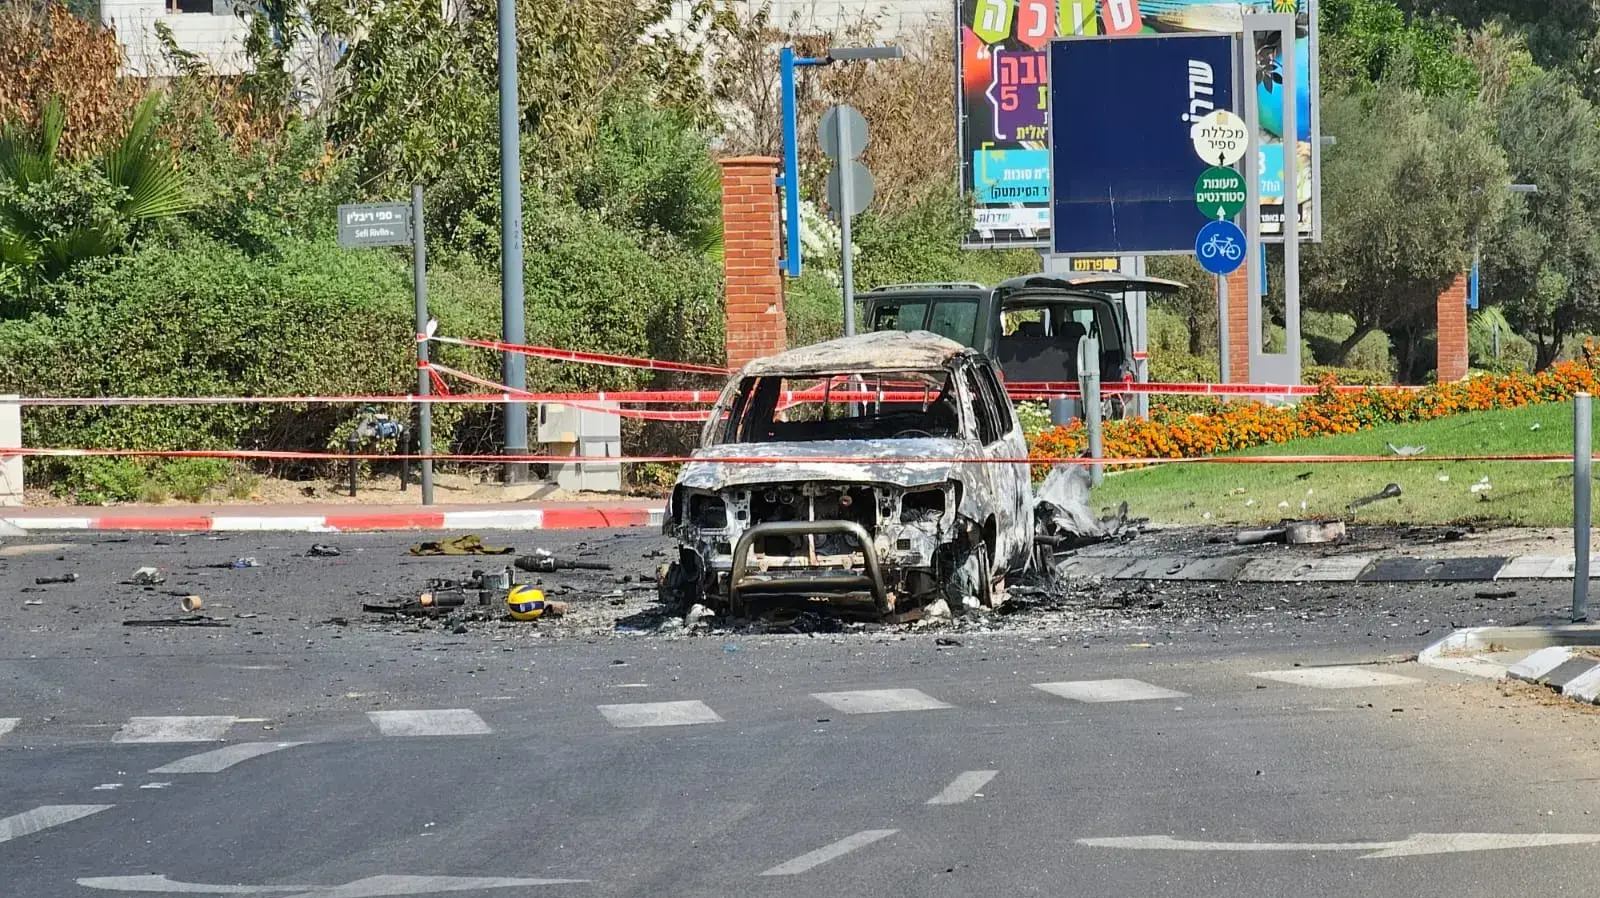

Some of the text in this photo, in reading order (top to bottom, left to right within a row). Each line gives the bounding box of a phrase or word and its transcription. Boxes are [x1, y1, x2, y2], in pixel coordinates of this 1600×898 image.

[1001, 86, 1018, 111] 5
[1200, 125, 1244, 139] מכללת
[1208, 140, 1236, 151] ספיר
[1003, 168, 1032, 181] סוכות
[1203, 178, 1239, 190] מעונות
[1196, 192, 1245, 203] סטודנטים
[346, 211, 374, 225] ריבלין
